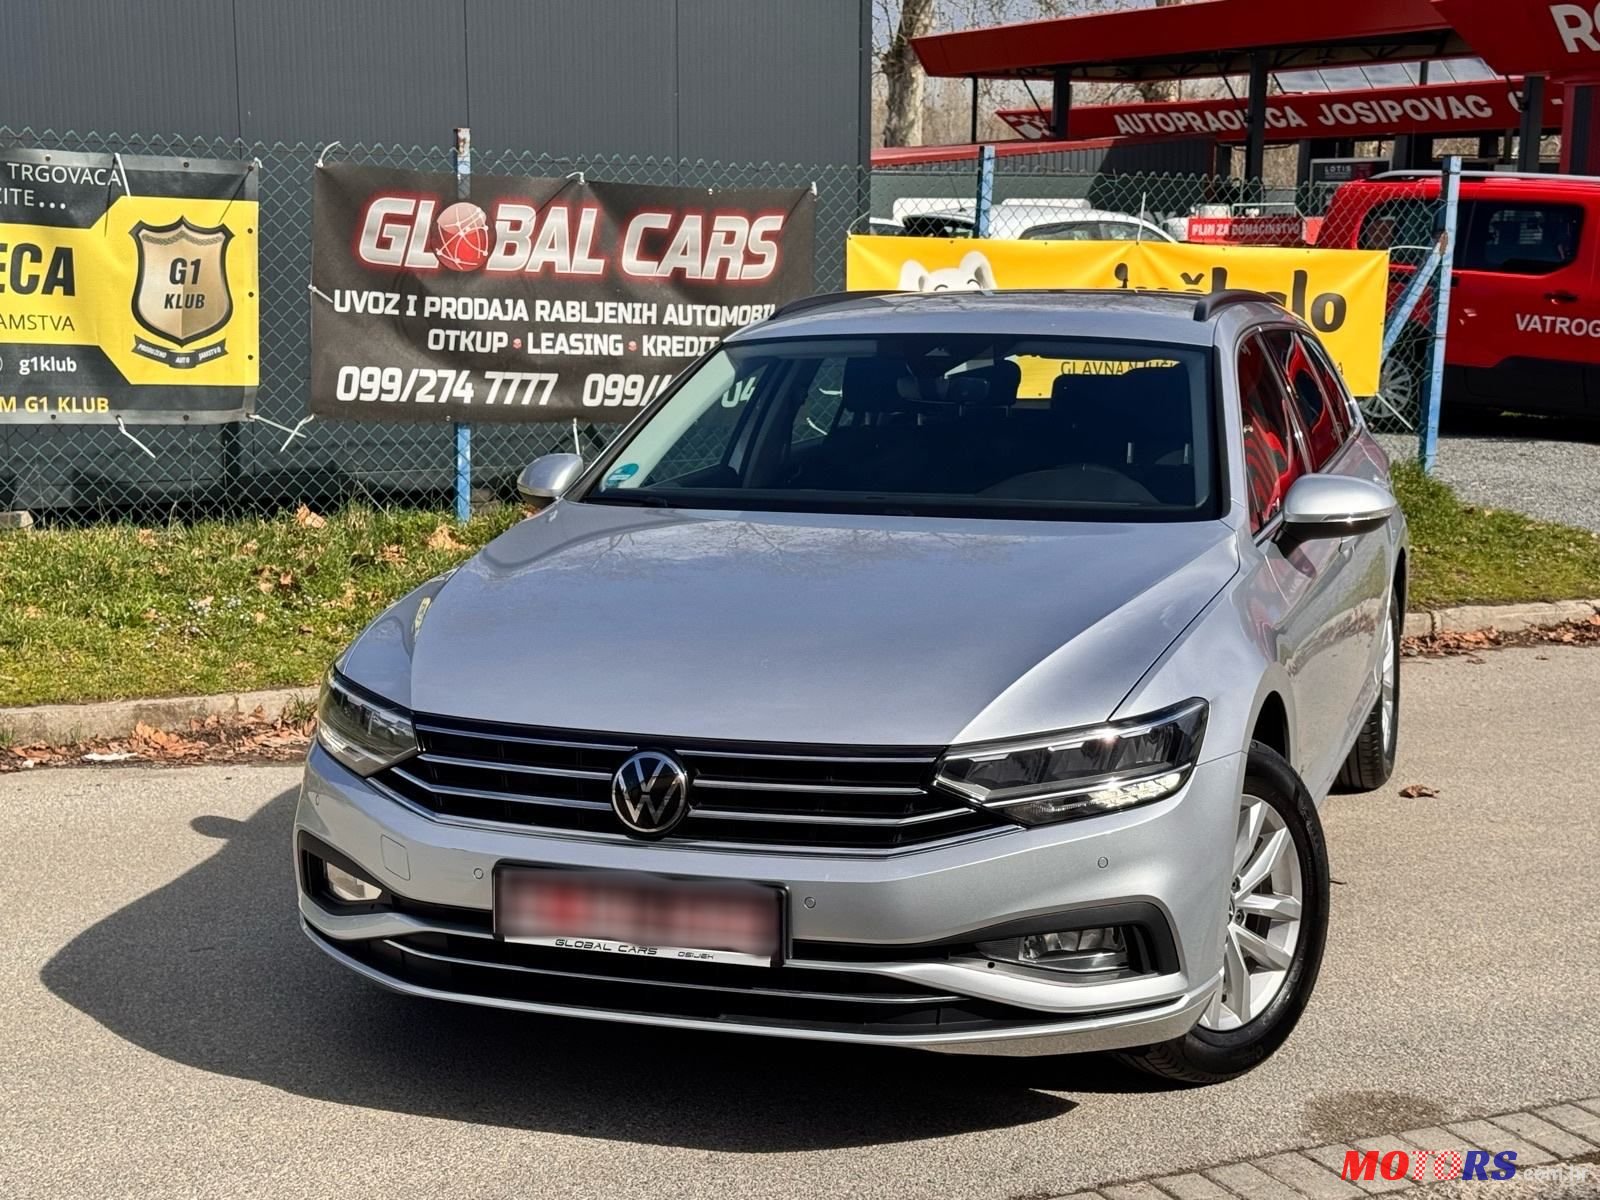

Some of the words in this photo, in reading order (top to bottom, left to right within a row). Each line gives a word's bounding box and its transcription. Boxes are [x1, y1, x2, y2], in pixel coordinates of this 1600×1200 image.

[1114, 105, 1308, 135] AUTOPRAOCA
[1318, 94, 1493, 126] JOSIPOVAC
[6, 162, 122, 187] TRGOVACA
[359, 197, 606, 275] GLOBAL
[621, 212, 784, 280] CARS
[1216, 223, 1229, 236] ZA
[169, 257, 202, 285] G1
[164, 293, 206, 310] KLUB
[334, 289, 400, 316] UVOZ
[405, 294, 417, 317] I
[424, 294, 529, 322] PRODAJA
[535, 298, 658, 326] RABLJENIH
[1515, 313, 1600, 338] VATROG
[427, 327, 509, 353] OTKUP
[527, 333, 625, 358] LEASING
[642, 335, 721, 358] KREDIT
[19, 355, 78, 376] g1klub
[336, 366, 475, 404] 099/274
[485, 370, 559, 407] 7777
[24, 396, 48, 414] G1
[58, 396, 110, 415] KLUB
[555, 937, 612, 951] GLOBAL
[617, 944, 658, 956] CARS
